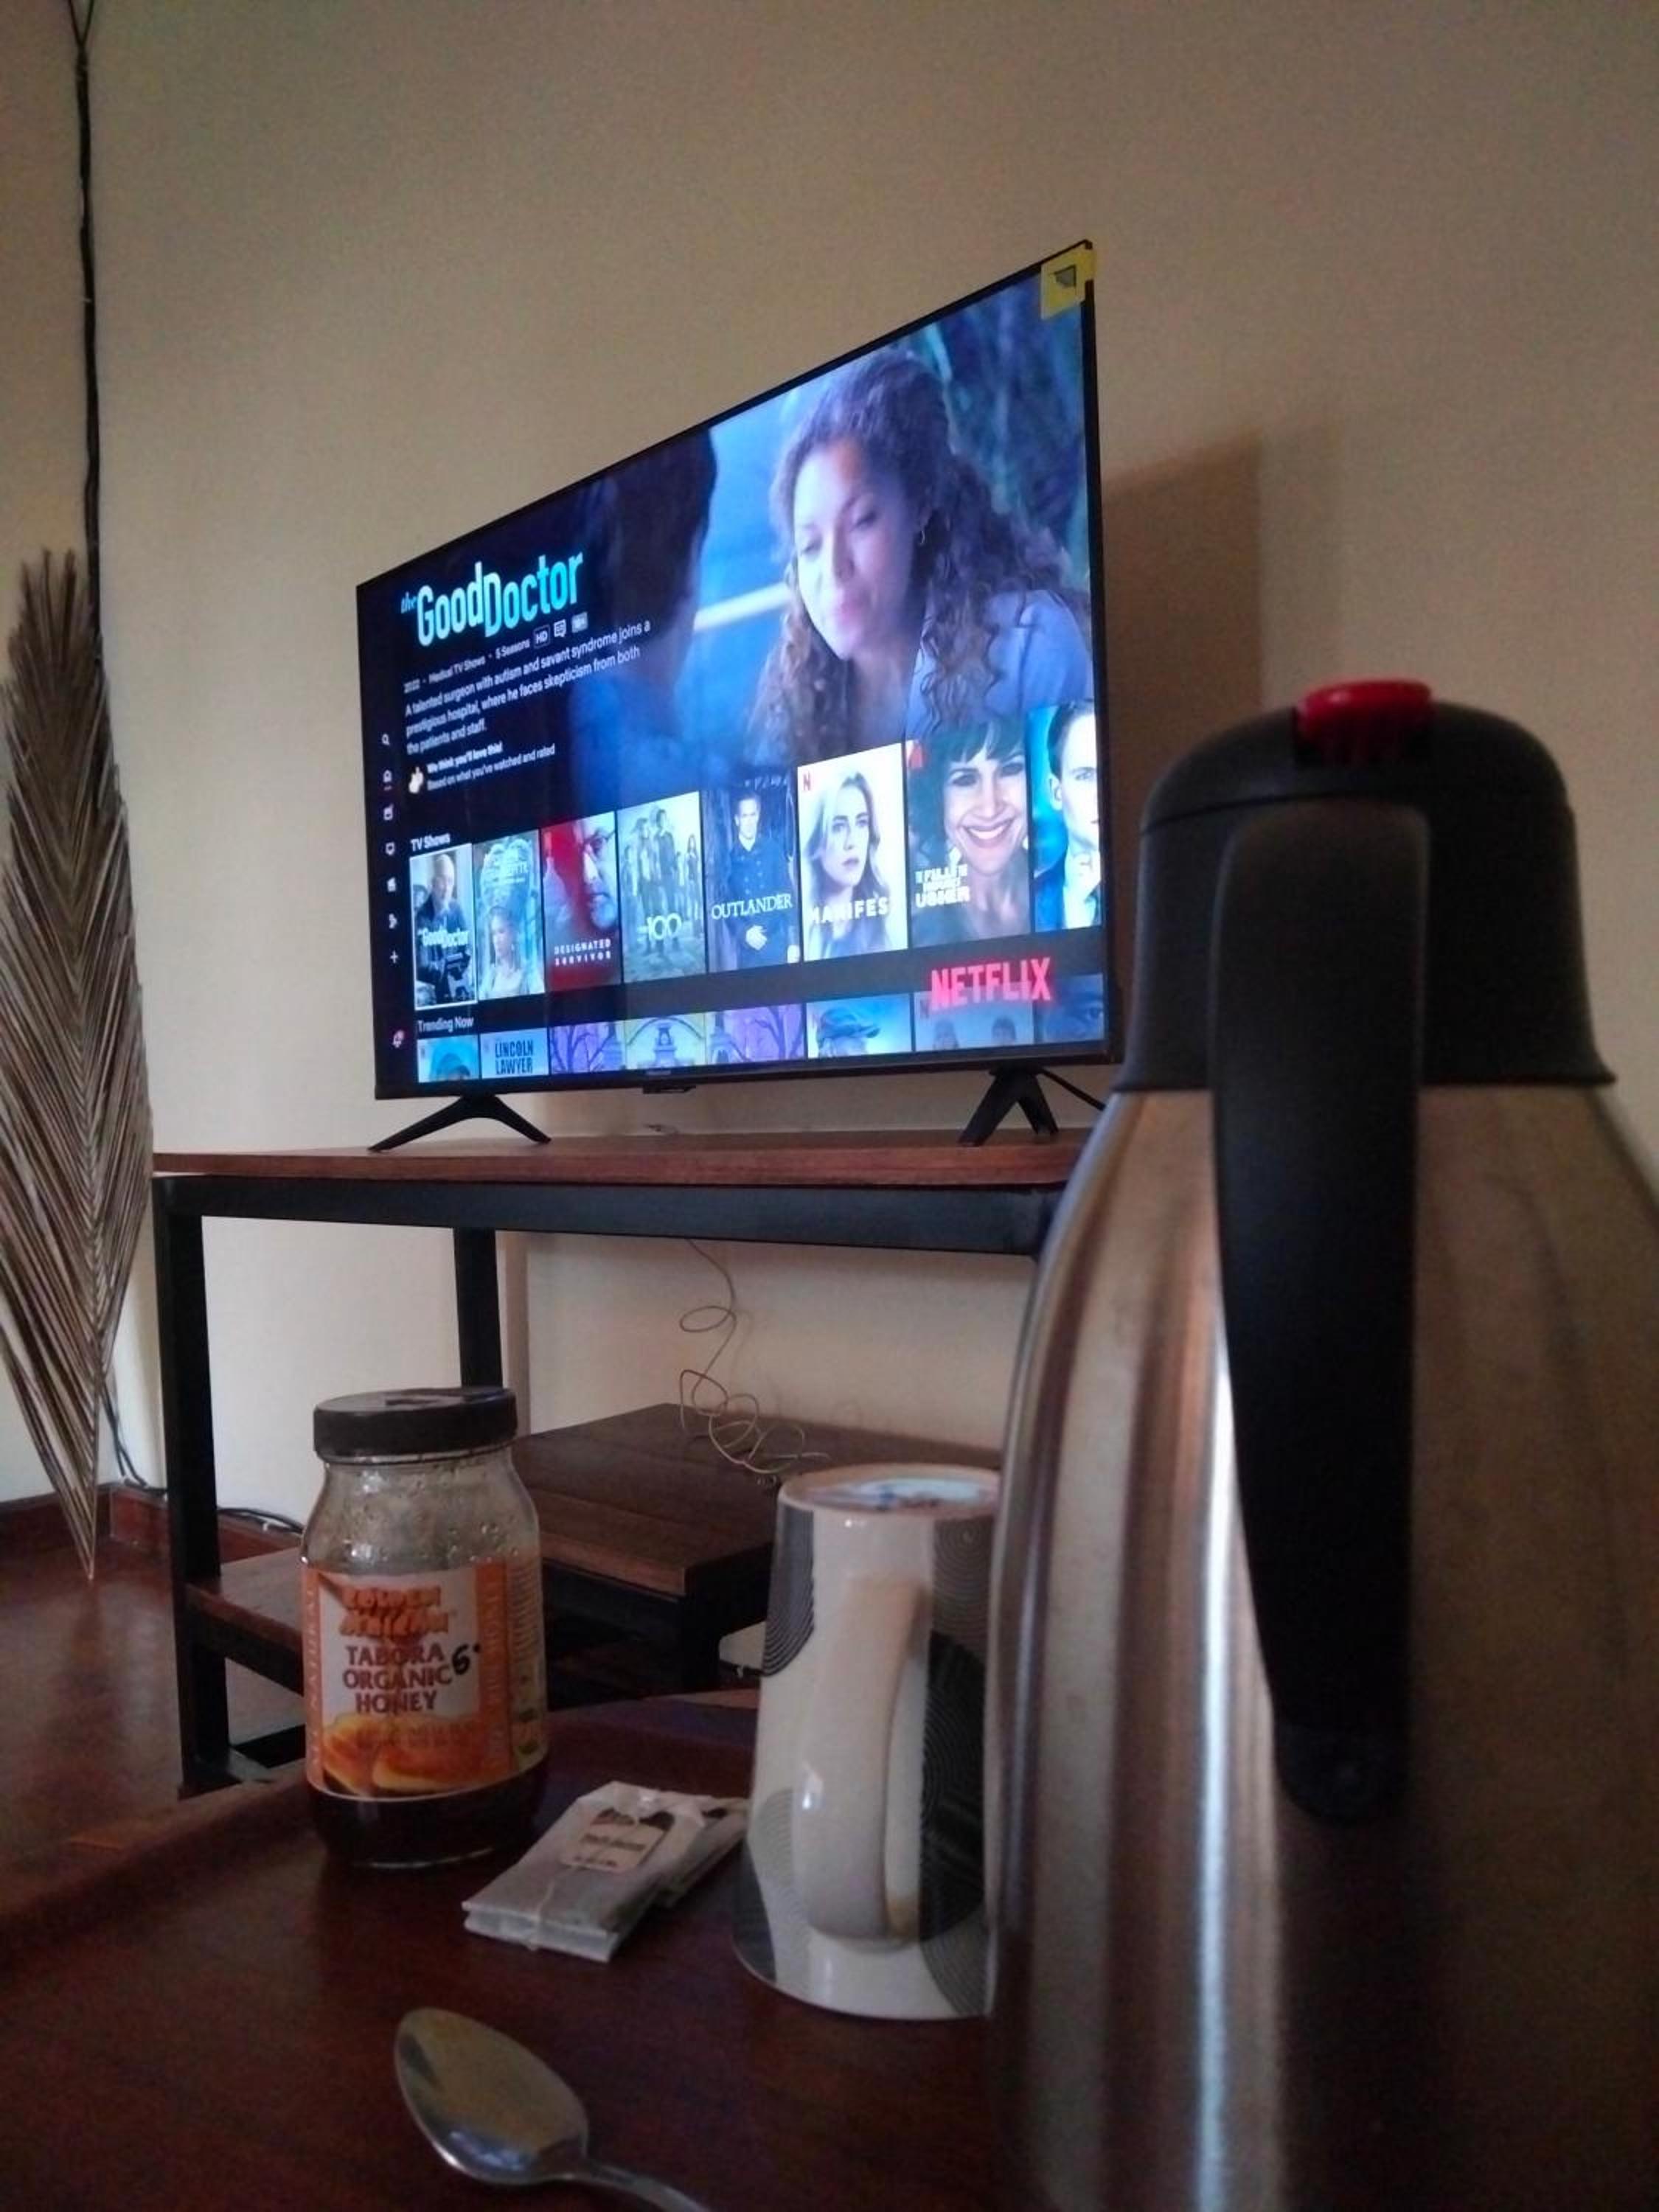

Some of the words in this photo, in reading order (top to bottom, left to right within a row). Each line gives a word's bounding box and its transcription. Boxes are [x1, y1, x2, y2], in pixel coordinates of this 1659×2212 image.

[400, 591, 417, 614] the
[453, 662, 463, 675] TV
[464, 655, 486, 672] Shows
[501, 639, 531, 657] Seasons
[535, 630, 549, 644] HD
[406, 703, 412, 717] A
[413, 691, 442, 714] talented
[444, 683, 476, 703] surgeon
[476, 674, 493, 692] with
[494, 666, 522, 686] autism
[523, 657, 540, 675] and
[540, 647, 570, 668] savant
[571, 631, 618, 658] syndrome
[618, 623, 642, 644] joins
[644, 620, 651, 633] a
[406, 713, 447, 738] prestigious
[448, 700, 481, 721] hospital,
[481, 693, 507, 710] where
[507, 687, 518, 702] he
[519, 680, 543, 698] faces
[544, 664, 591, 689] skepticism
[594, 655, 616, 672] from
[617, 645, 641, 664] both
[406, 742, 420, 756] the
[420, 731, 451, 754] patients
[451, 725, 466, 742] and
[467, 717, 487, 736] staff.
[426, 762, 438, 774] We
[438, 757, 453, 770] think
[473, 748, 487, 761] love
[447, 775, 456, 786] on
[456, 769, 472, 783] what
[493, 754, 522, 771] watched
[523, 749, 536, 764] and
[537, 742, 555, 759] rated
[410, 838, 424, 852] TV
[424, 832, 451, 849] Shows
[711, 893, 793, 920] OUTLANDER
[554, 938, 612, 955] DESIGNATED
[554, 950, 612, 967] SURVIVOR
[931, 956, 1051, 1012] NETFLIX
[417, 1017, 453, 1033] Trending
[454, 1015, 475, 1029] Now
[495, 1040, 535, 1057] LINCOLN
[495, 1057, 534, 1075] LAWYER
[342, 1664, 453, 1691] ORGANIC
[355, 1690, 438, 1714] HONEY
